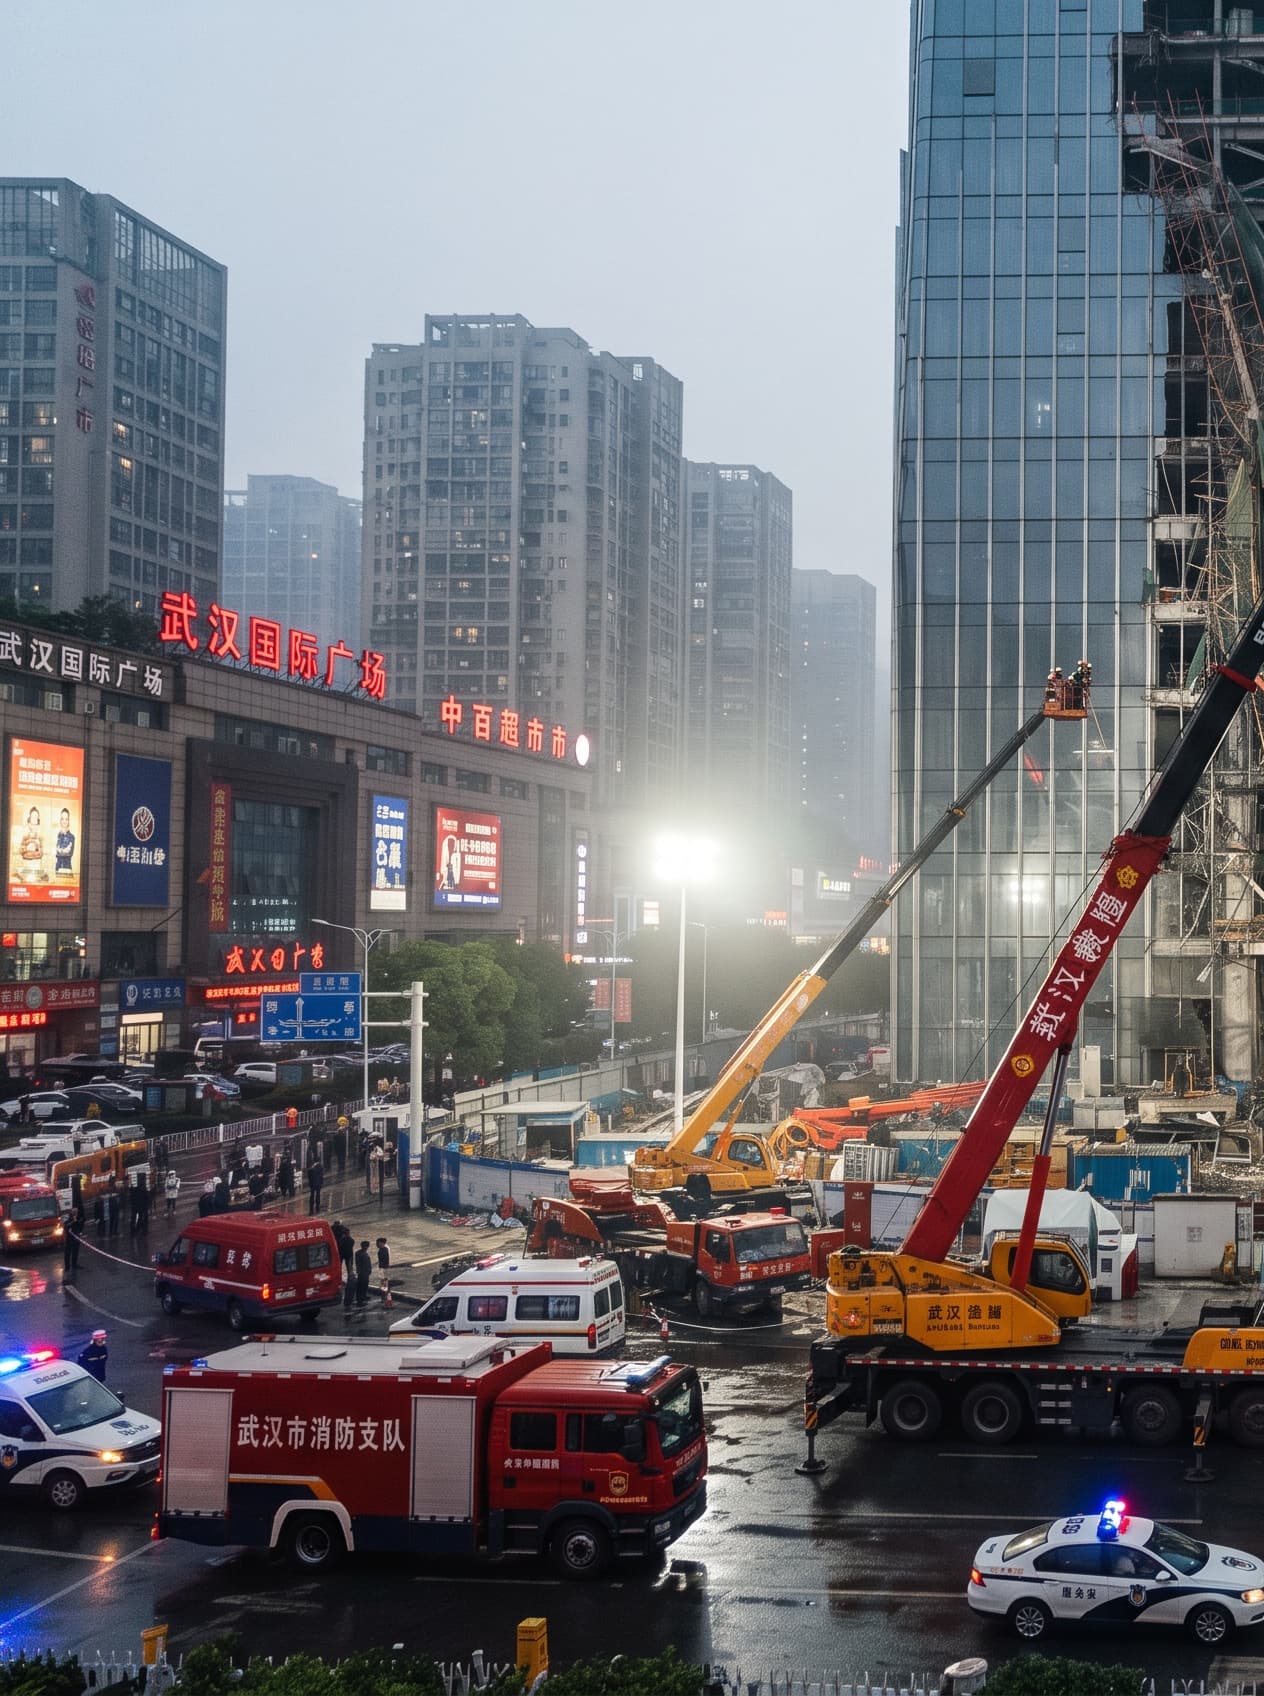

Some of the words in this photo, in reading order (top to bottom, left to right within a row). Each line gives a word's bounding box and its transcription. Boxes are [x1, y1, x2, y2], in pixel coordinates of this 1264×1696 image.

[0, 631, 163, 696] 武汉国际广场
[160, 591, 388, 700] 武汉国际广场
[441, 695, 567, 759] 中百超市市
[237, 1414, 405, 1451] 武汉市消防支队
